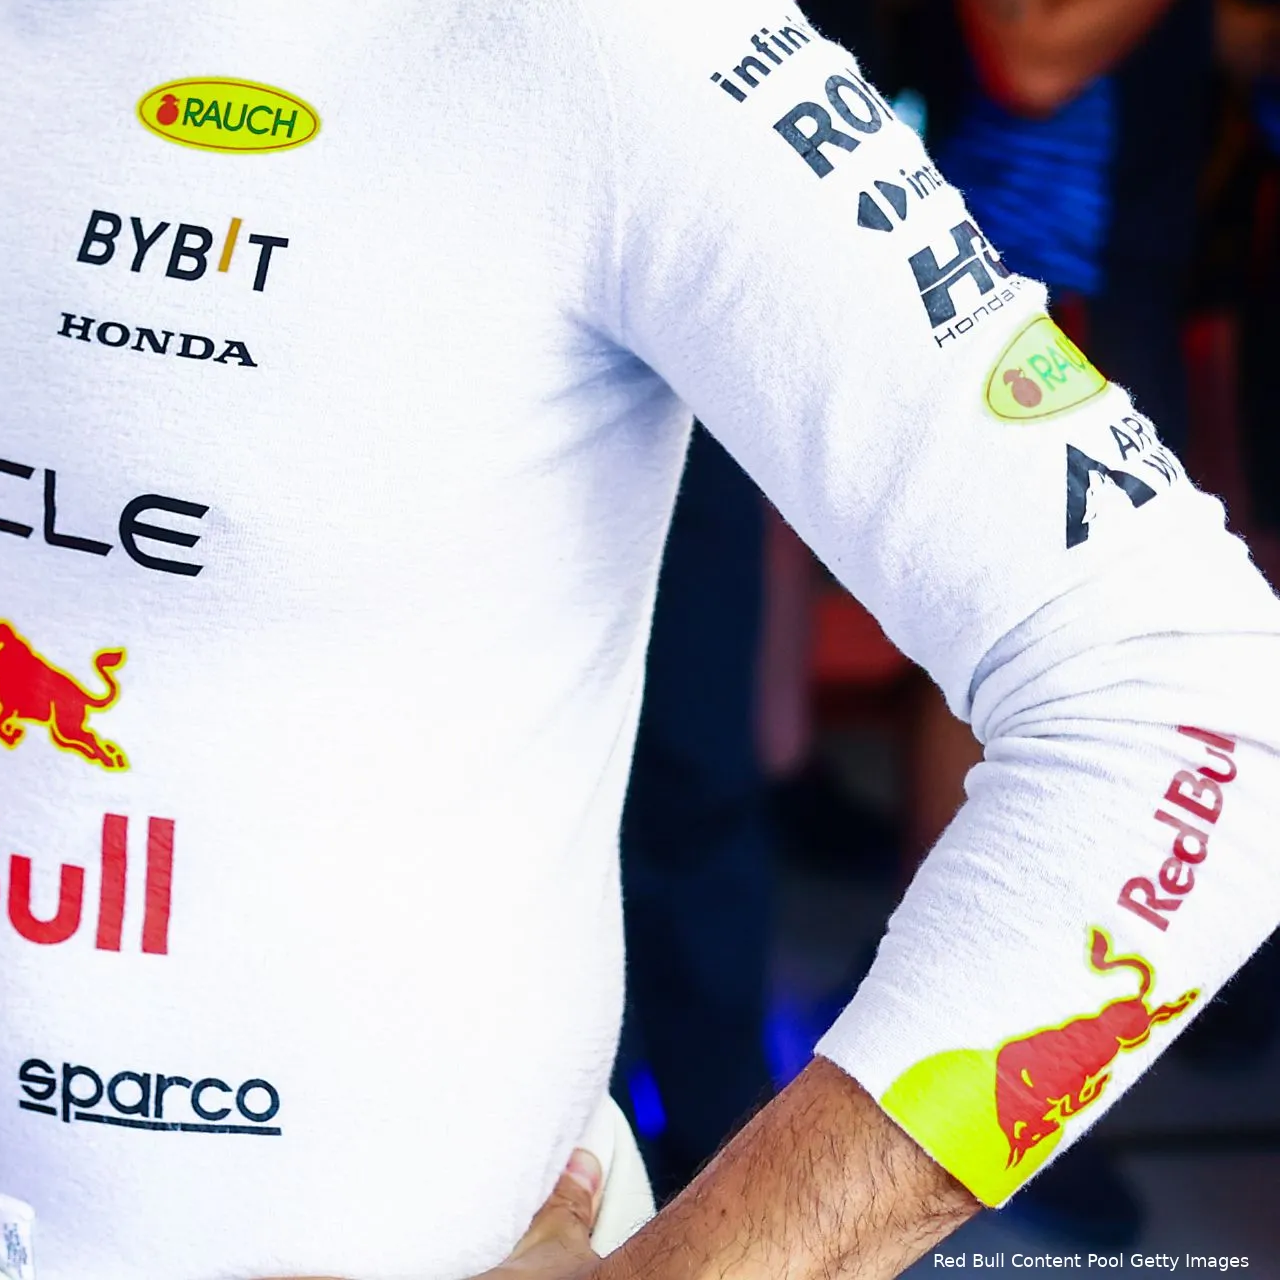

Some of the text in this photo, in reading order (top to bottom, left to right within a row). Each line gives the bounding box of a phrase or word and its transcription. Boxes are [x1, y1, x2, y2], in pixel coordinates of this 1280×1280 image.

[181, 97, 300, 140] RAUCH
[772, 67, 894, 179] RO
[77, 209, 289, 292] BYBIT
[57, 313, 259, 368] HONDA
[934, 288, 1015, 348] Honda
[1117, 809, 1209, 932] Red
[18, 1058, 281, 1124] sparco
